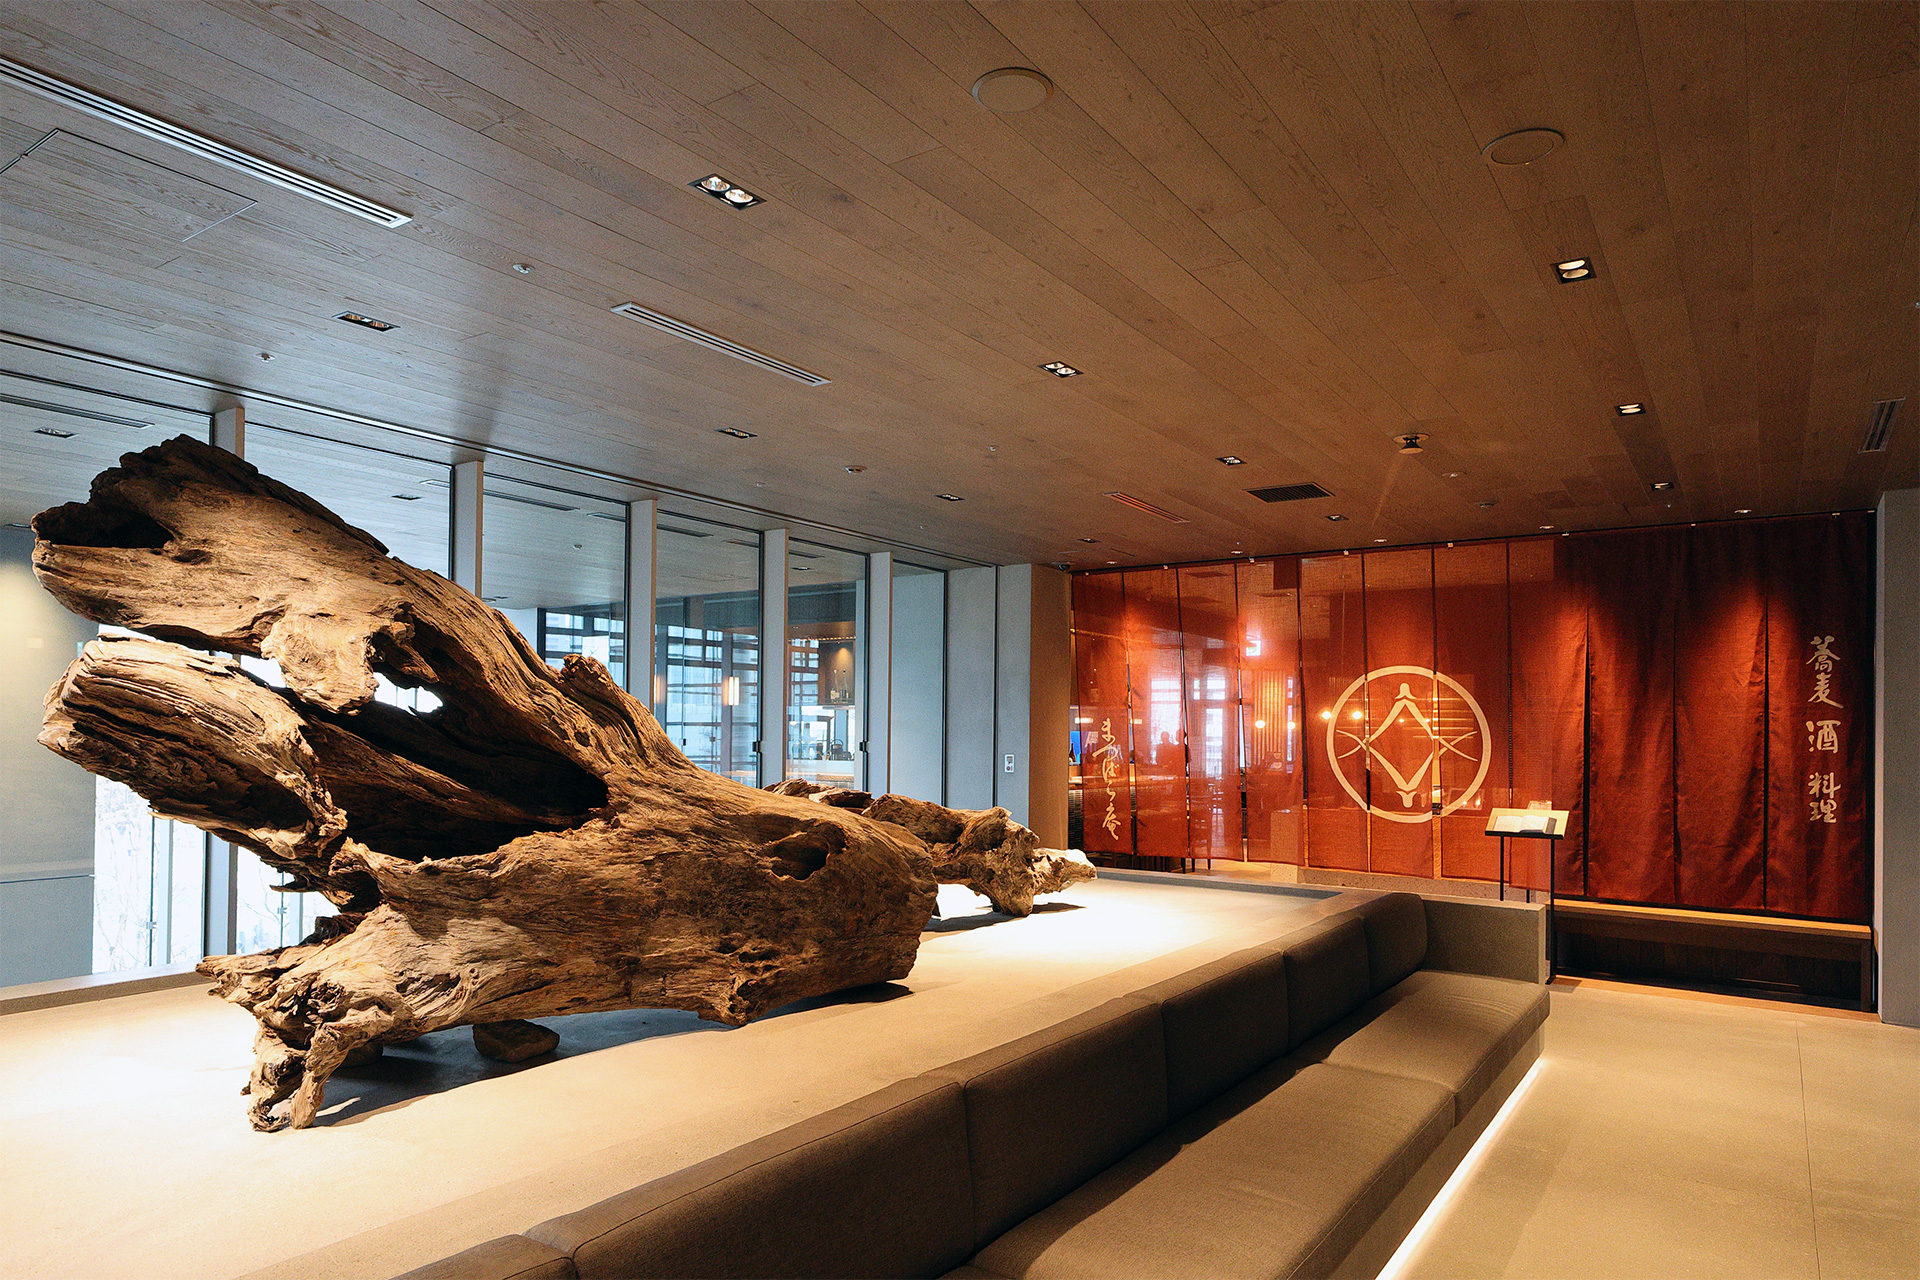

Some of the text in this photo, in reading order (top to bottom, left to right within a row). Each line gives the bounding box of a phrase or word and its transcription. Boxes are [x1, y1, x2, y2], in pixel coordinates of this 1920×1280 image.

[1805, 635, 1844, 823] 蕎麦 酒 料理
